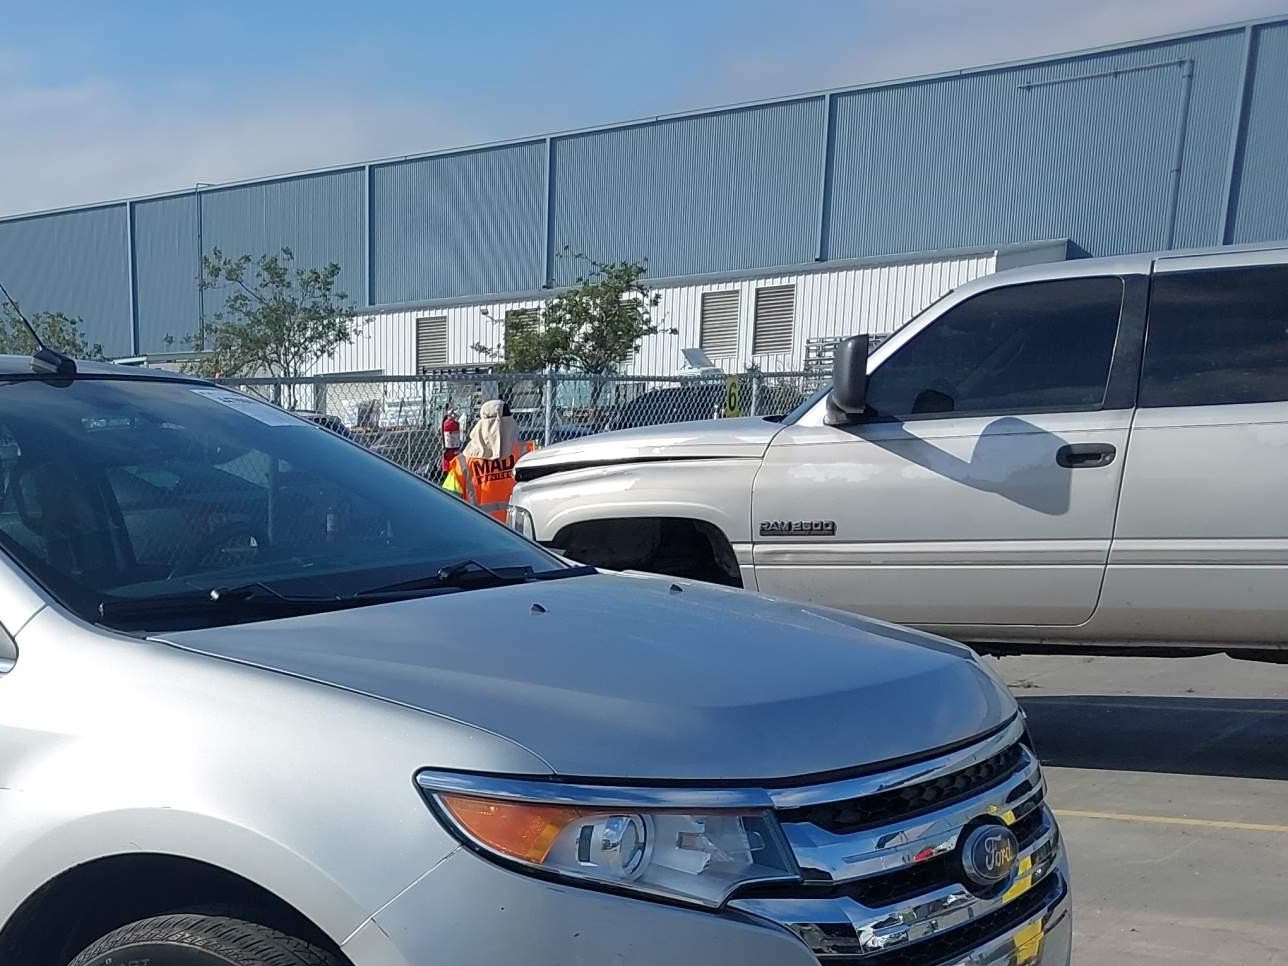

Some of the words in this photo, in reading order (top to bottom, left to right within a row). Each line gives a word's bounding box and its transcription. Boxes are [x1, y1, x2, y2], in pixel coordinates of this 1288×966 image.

[728, 382, 737, 411] 6
[760, 520, 792, 531] RAM
[984, 834, 1013, 871] Ford
